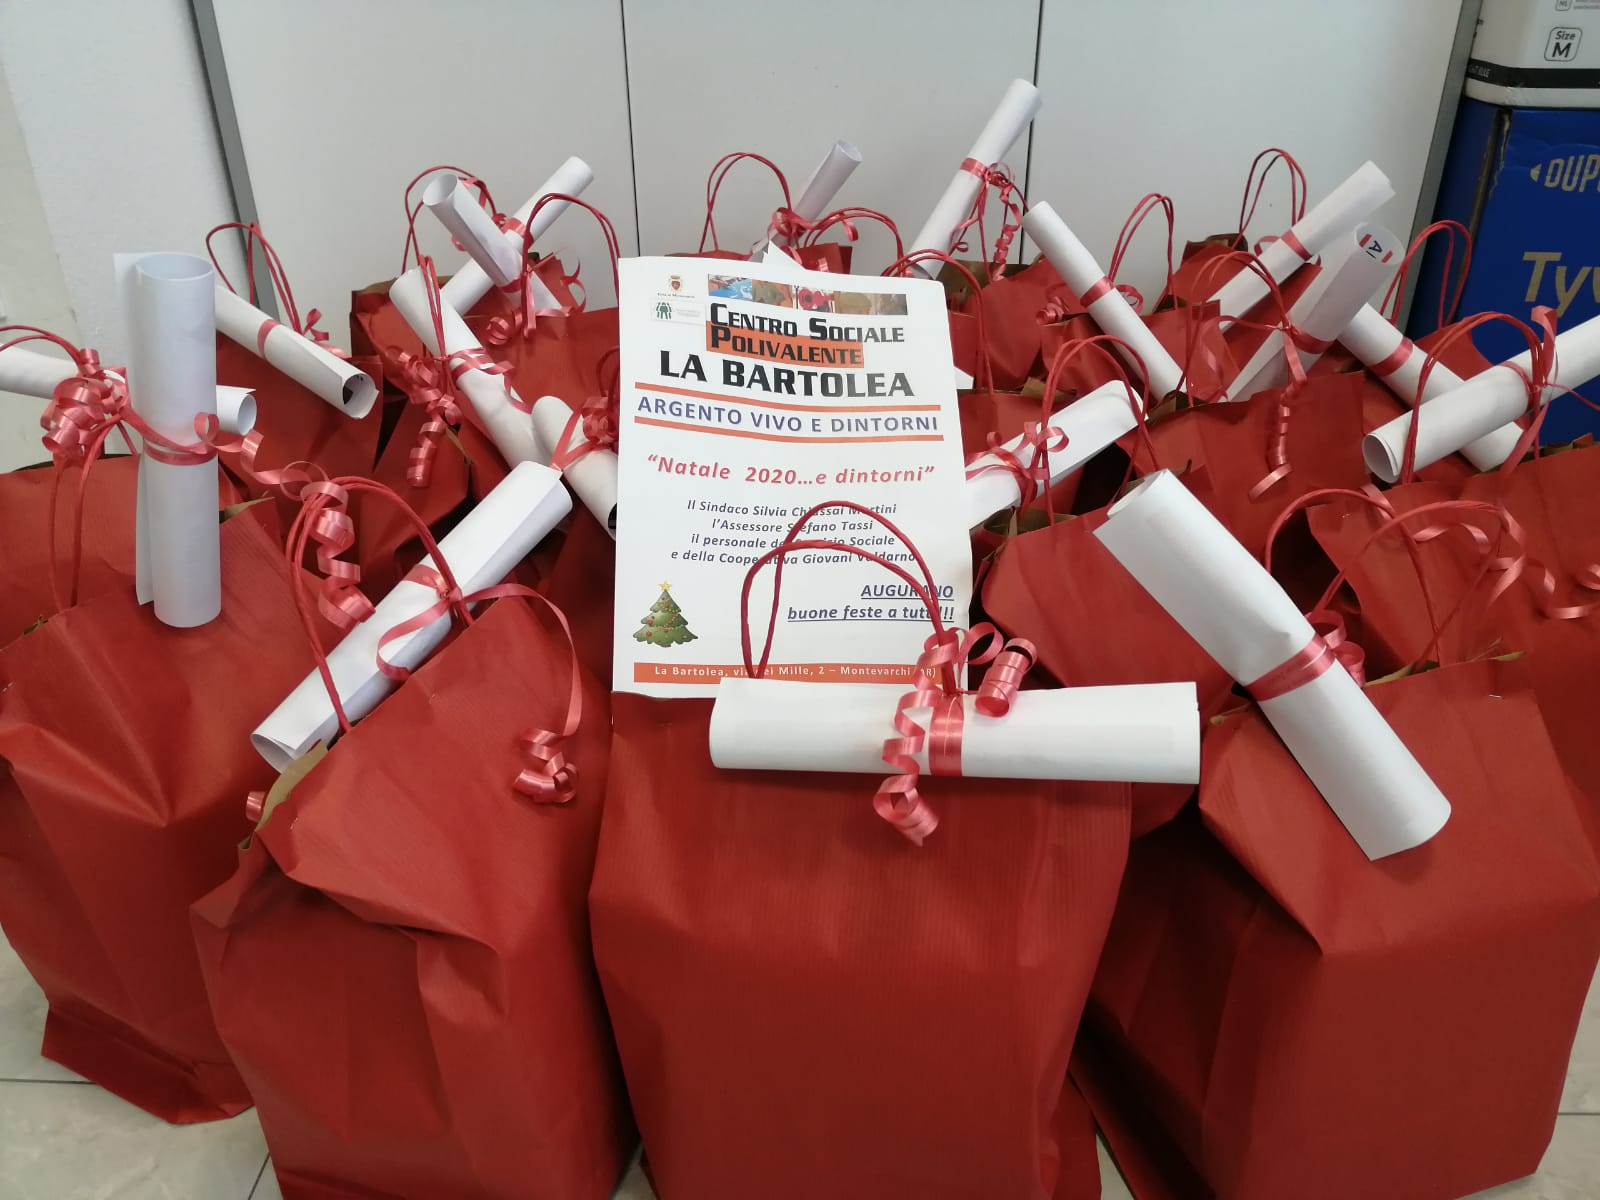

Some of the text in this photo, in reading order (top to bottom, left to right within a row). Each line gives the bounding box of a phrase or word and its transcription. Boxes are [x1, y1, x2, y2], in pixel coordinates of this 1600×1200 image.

[1555, 30, 1576, 40] Size
[1551, 42, 1572, 58] M
[1544, 154, 1600, 192] DUP
[710, 325, 862, 365] POLIVALENTE
[660, 350, 915, 398] LA BARTOLEA
[637, 396, 938, 433] ARGENTO VIVO E DINTORNI
[648, 454, 731, 480] “Natale
[835, 465, 935, 484] dintorni”
[687, 499, 696, 510] Il
[699, 501, 749, 515] Sindaco
[752, 505, 787, 517] Silvia
[712, 518, 873, 535] l’Assessore Sefano Tassi
[691, 533, 700, 544] il
[703, 536, 767, 549] personale
[849, 535, 895, 546] Sociale
[671, 551, 679, 559] e
[682, 549, 715, 562] della
[802, 553, 852, 564] Giovani
[787, 606, 838, 620] buone
[843, 605, 883, 621] feste
[888, 609, 898, 618] a
[655, 666, 667, 675] La
[672, 666, 729, 677] Bartolea,
[779, 666, 814, 676] Mille,
[818, 666, 825, 675] 2
[840, 666, 911, 677] Montevarchi
